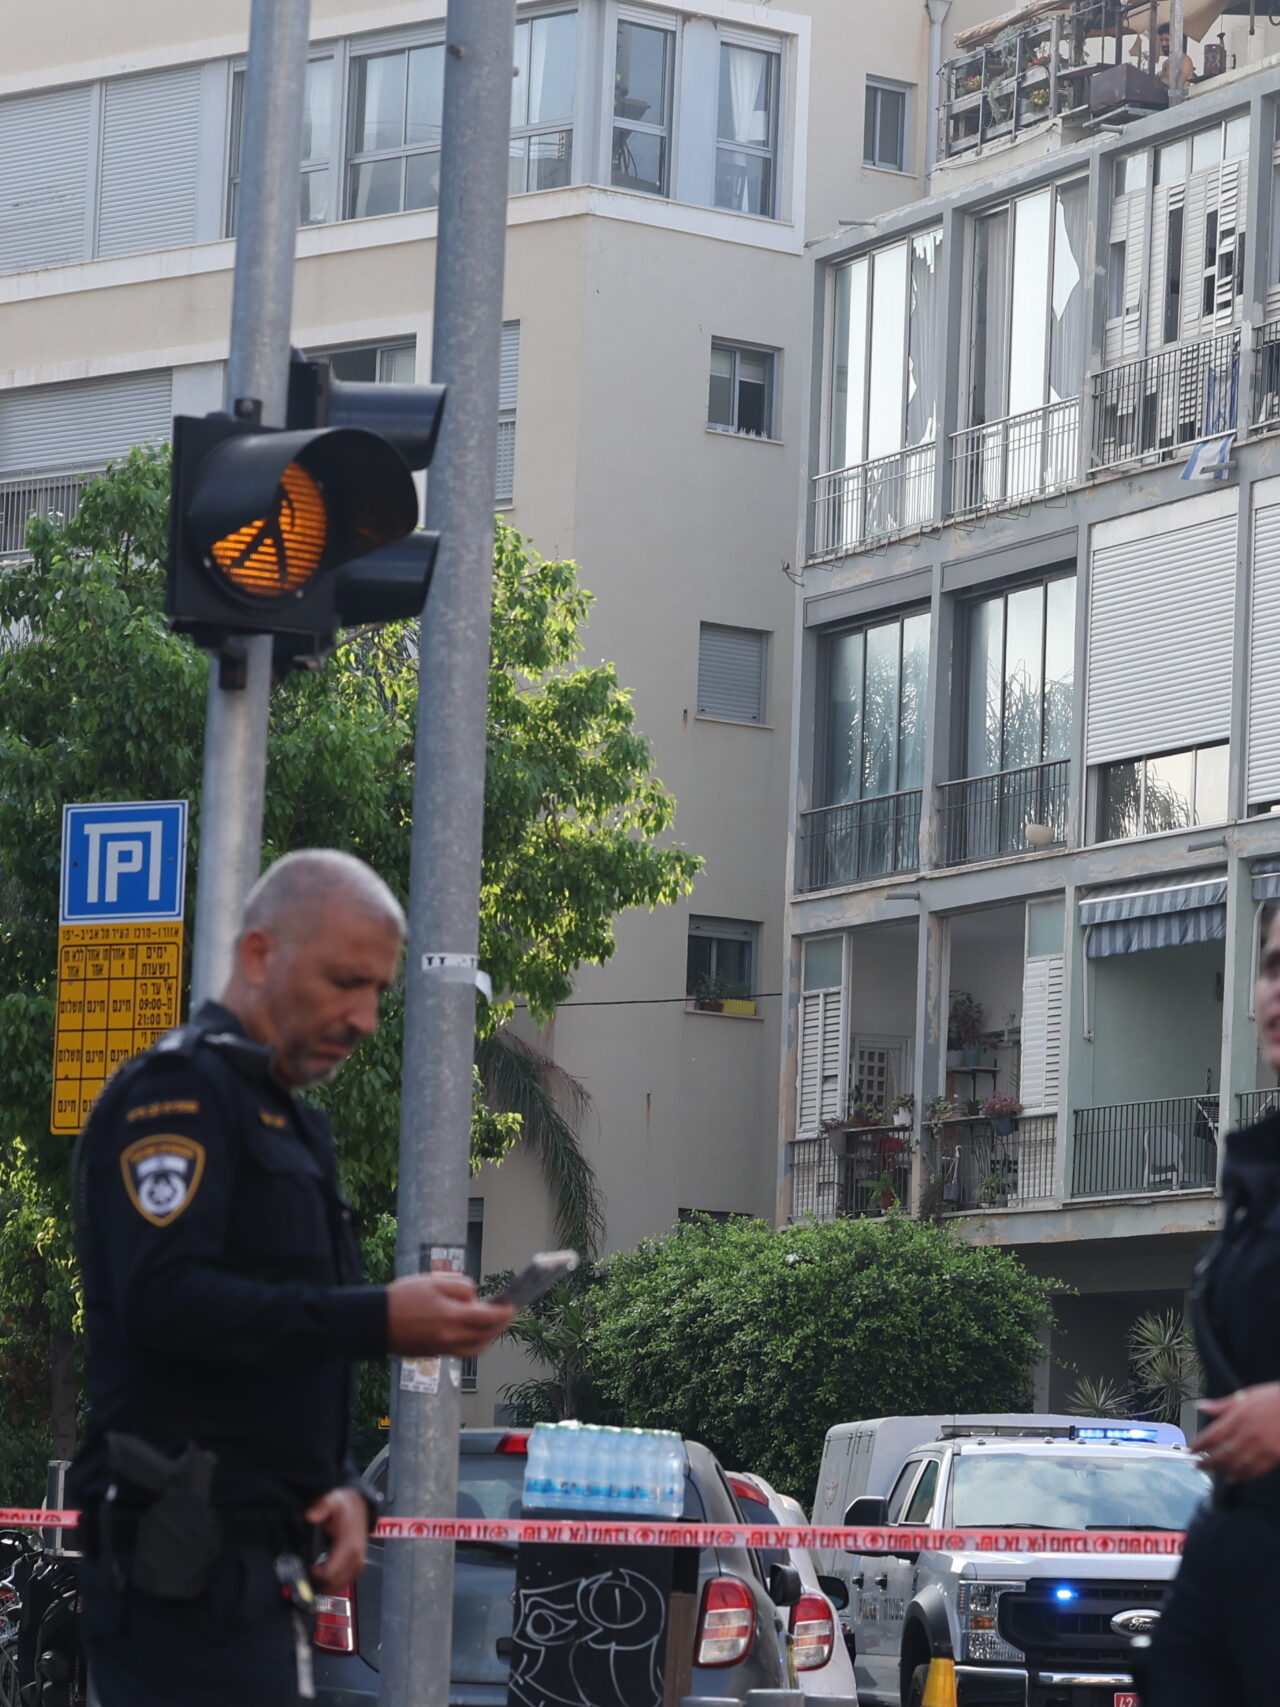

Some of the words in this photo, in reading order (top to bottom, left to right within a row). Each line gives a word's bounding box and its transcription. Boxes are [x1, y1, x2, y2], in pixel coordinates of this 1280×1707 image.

[112, 928, 129, 939] העיר
[146, 946, 167, 959] ימים
[142, 963, 170, 976] ושעות
[60, 999, 83, 1014] תשלום
[87, 1000, 105, 1013] חינם
[113, 1000, 131, 1013] חינם
[138, 1013, 161, 1026] 21:00
[58, 1048, 82, 1062] תשלום
[86, 1050, 104, 1063] חינם
[111, 1049, 129, 1062] חינם
[58, 1100, 76, 1113] חינם
[591, 1527, 628, 1542] מעבר
[659, 1529, 714, 1545] משטרת
[745, 1530, 792, 1548] ישראל
[820, 1532, 858, 1548] מעבר
[888, 1534, 943, 1550] משטרת
[975, 1535, 1022, 1552] ישראל
[1049, 1536, 1087, 1552] מעבר
